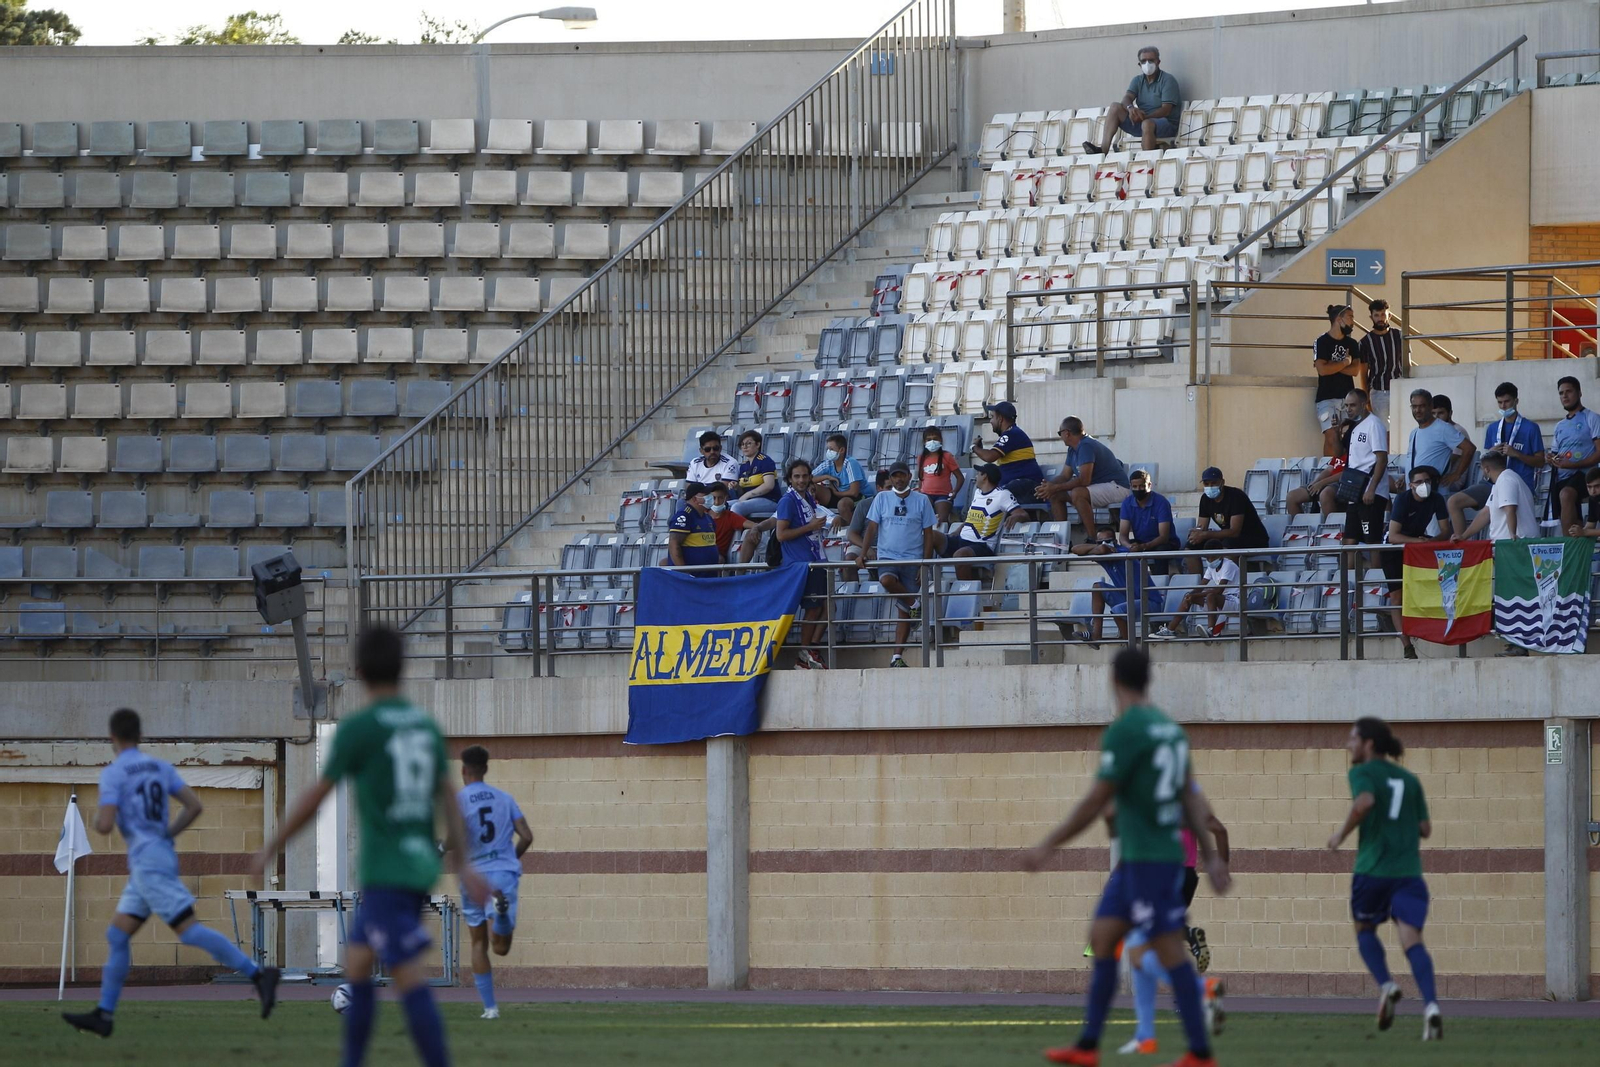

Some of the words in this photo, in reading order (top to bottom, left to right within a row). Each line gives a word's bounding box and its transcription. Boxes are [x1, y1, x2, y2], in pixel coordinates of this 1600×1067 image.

[1332, 260, 1354, 268] Salida
[136, 781, 163, 822] 18
[469, 790, 495, 803] CHECA
[1387, 777, 1405, 819] 7
[479, 806, 495, 844] 5
